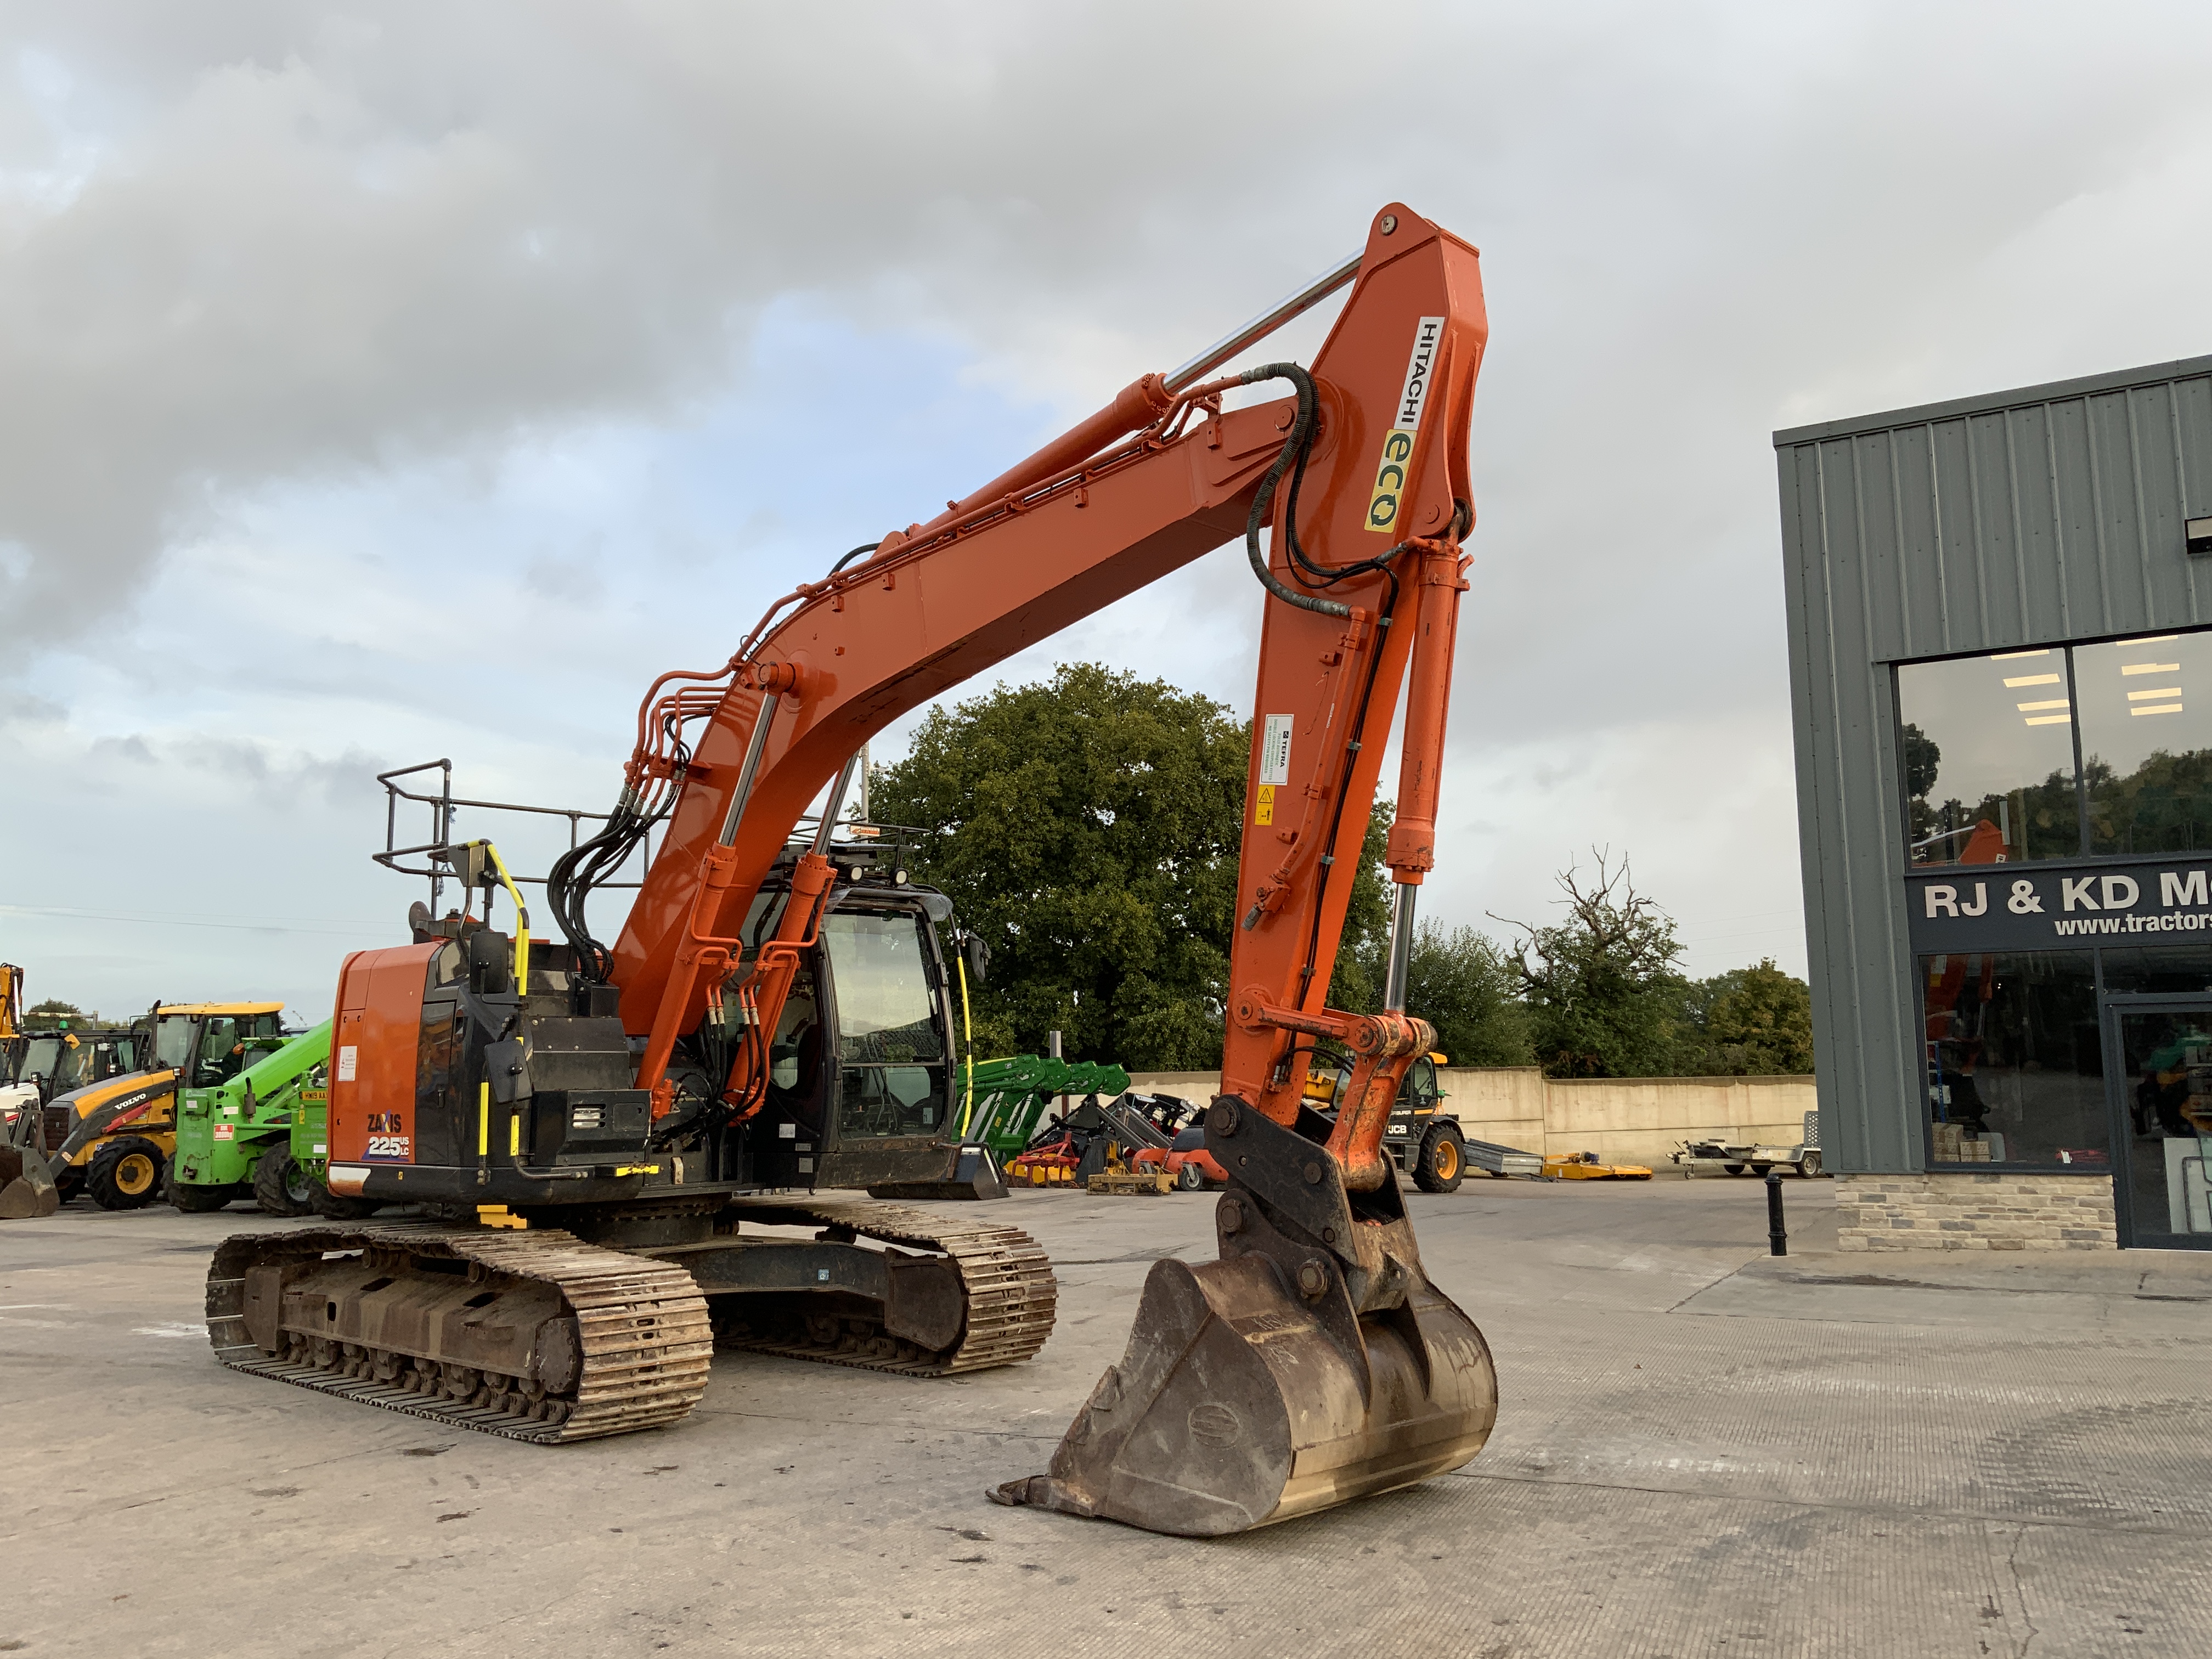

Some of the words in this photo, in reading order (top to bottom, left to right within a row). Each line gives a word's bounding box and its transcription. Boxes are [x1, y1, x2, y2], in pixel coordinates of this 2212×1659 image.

[1401, 324, 1437, 423] HITACHI
[1925, 882, 1988, 918] RJ
[2007, 879, 2045, 915] &
[2061, 875, 2140, 912] KD
[2160, 870, 2212, 907] M
[2055, 911, 2212, 936] www.tractor
[114, 1093, 146, 1110] VOLVO
[367, 1109, 402, 1133] ZAXIS
[1388, 1125, 1407, 1134] JCB
[369, 1136, 401, 1157] 225
[400, 1136, 410, 1146] US
[400, 1147, 410, 1156] LC
